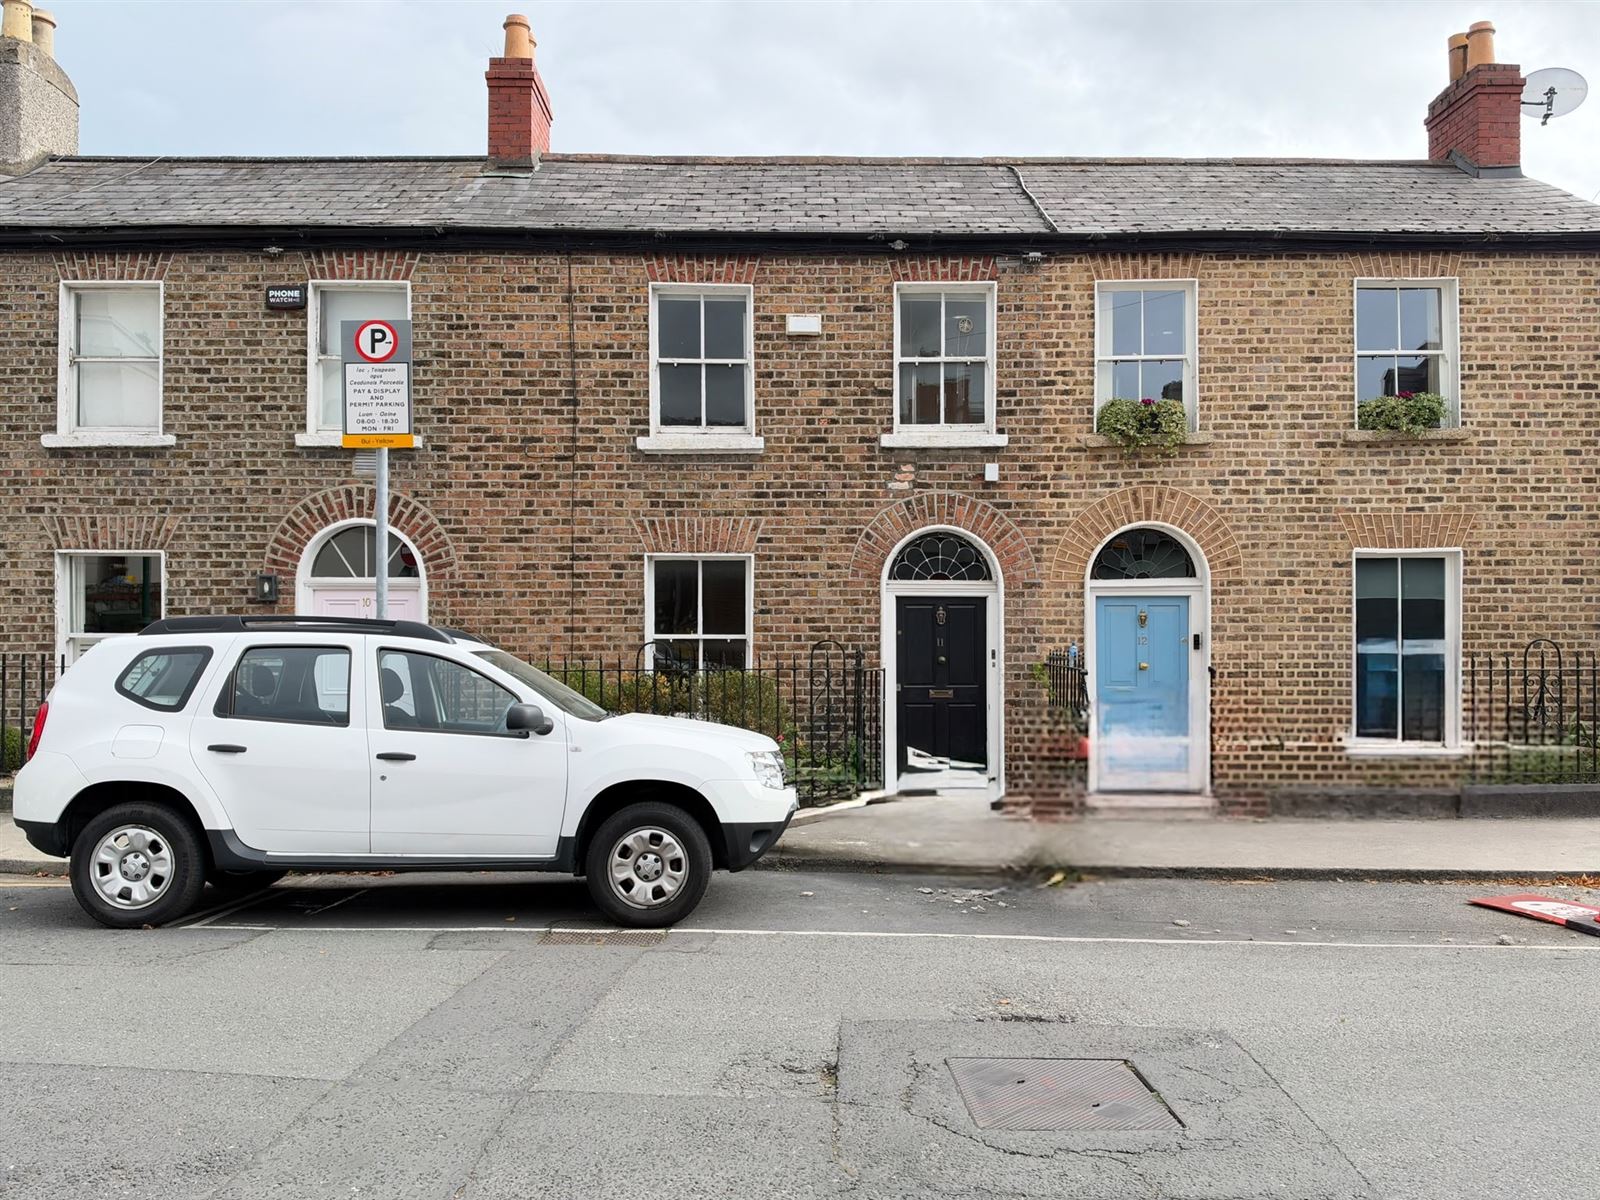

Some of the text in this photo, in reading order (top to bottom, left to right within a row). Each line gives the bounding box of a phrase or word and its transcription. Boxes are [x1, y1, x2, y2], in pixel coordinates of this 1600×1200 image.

[370, 328, 387, 354] P
[362, 598, 370, 608] 10
[936, 638, 944, 646] 11
[1138, 636, 1148, 646] 12
